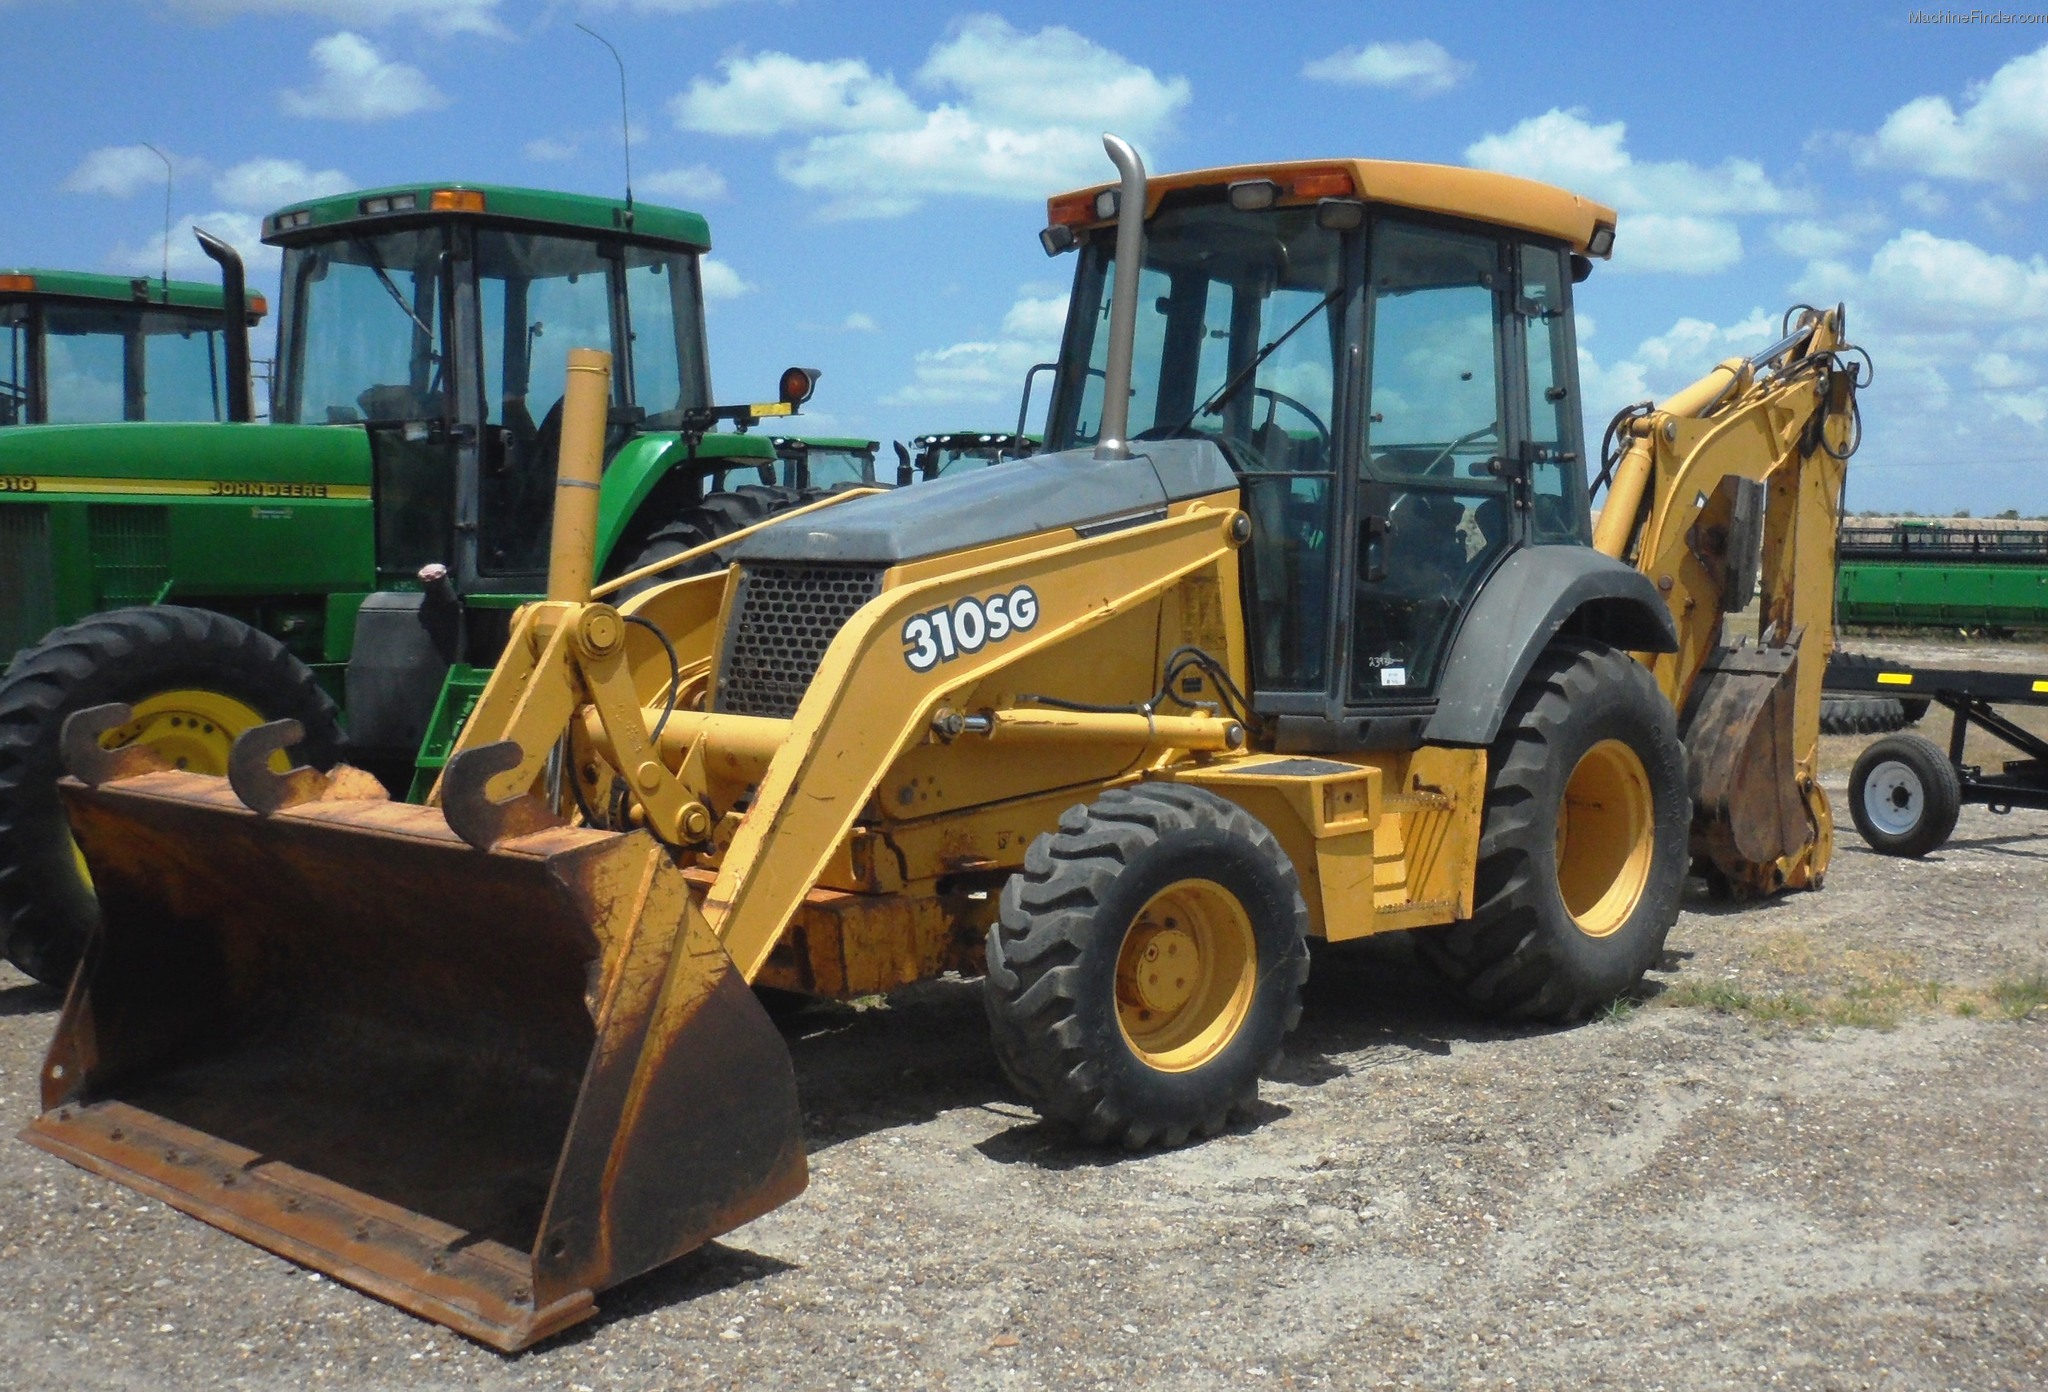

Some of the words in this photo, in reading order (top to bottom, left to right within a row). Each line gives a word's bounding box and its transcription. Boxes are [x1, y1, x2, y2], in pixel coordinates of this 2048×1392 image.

[209, 481, 263, 496] JOHN
[263, 482, 328, 497] DEERE
[902, 584, 1039, 673] 310SG
